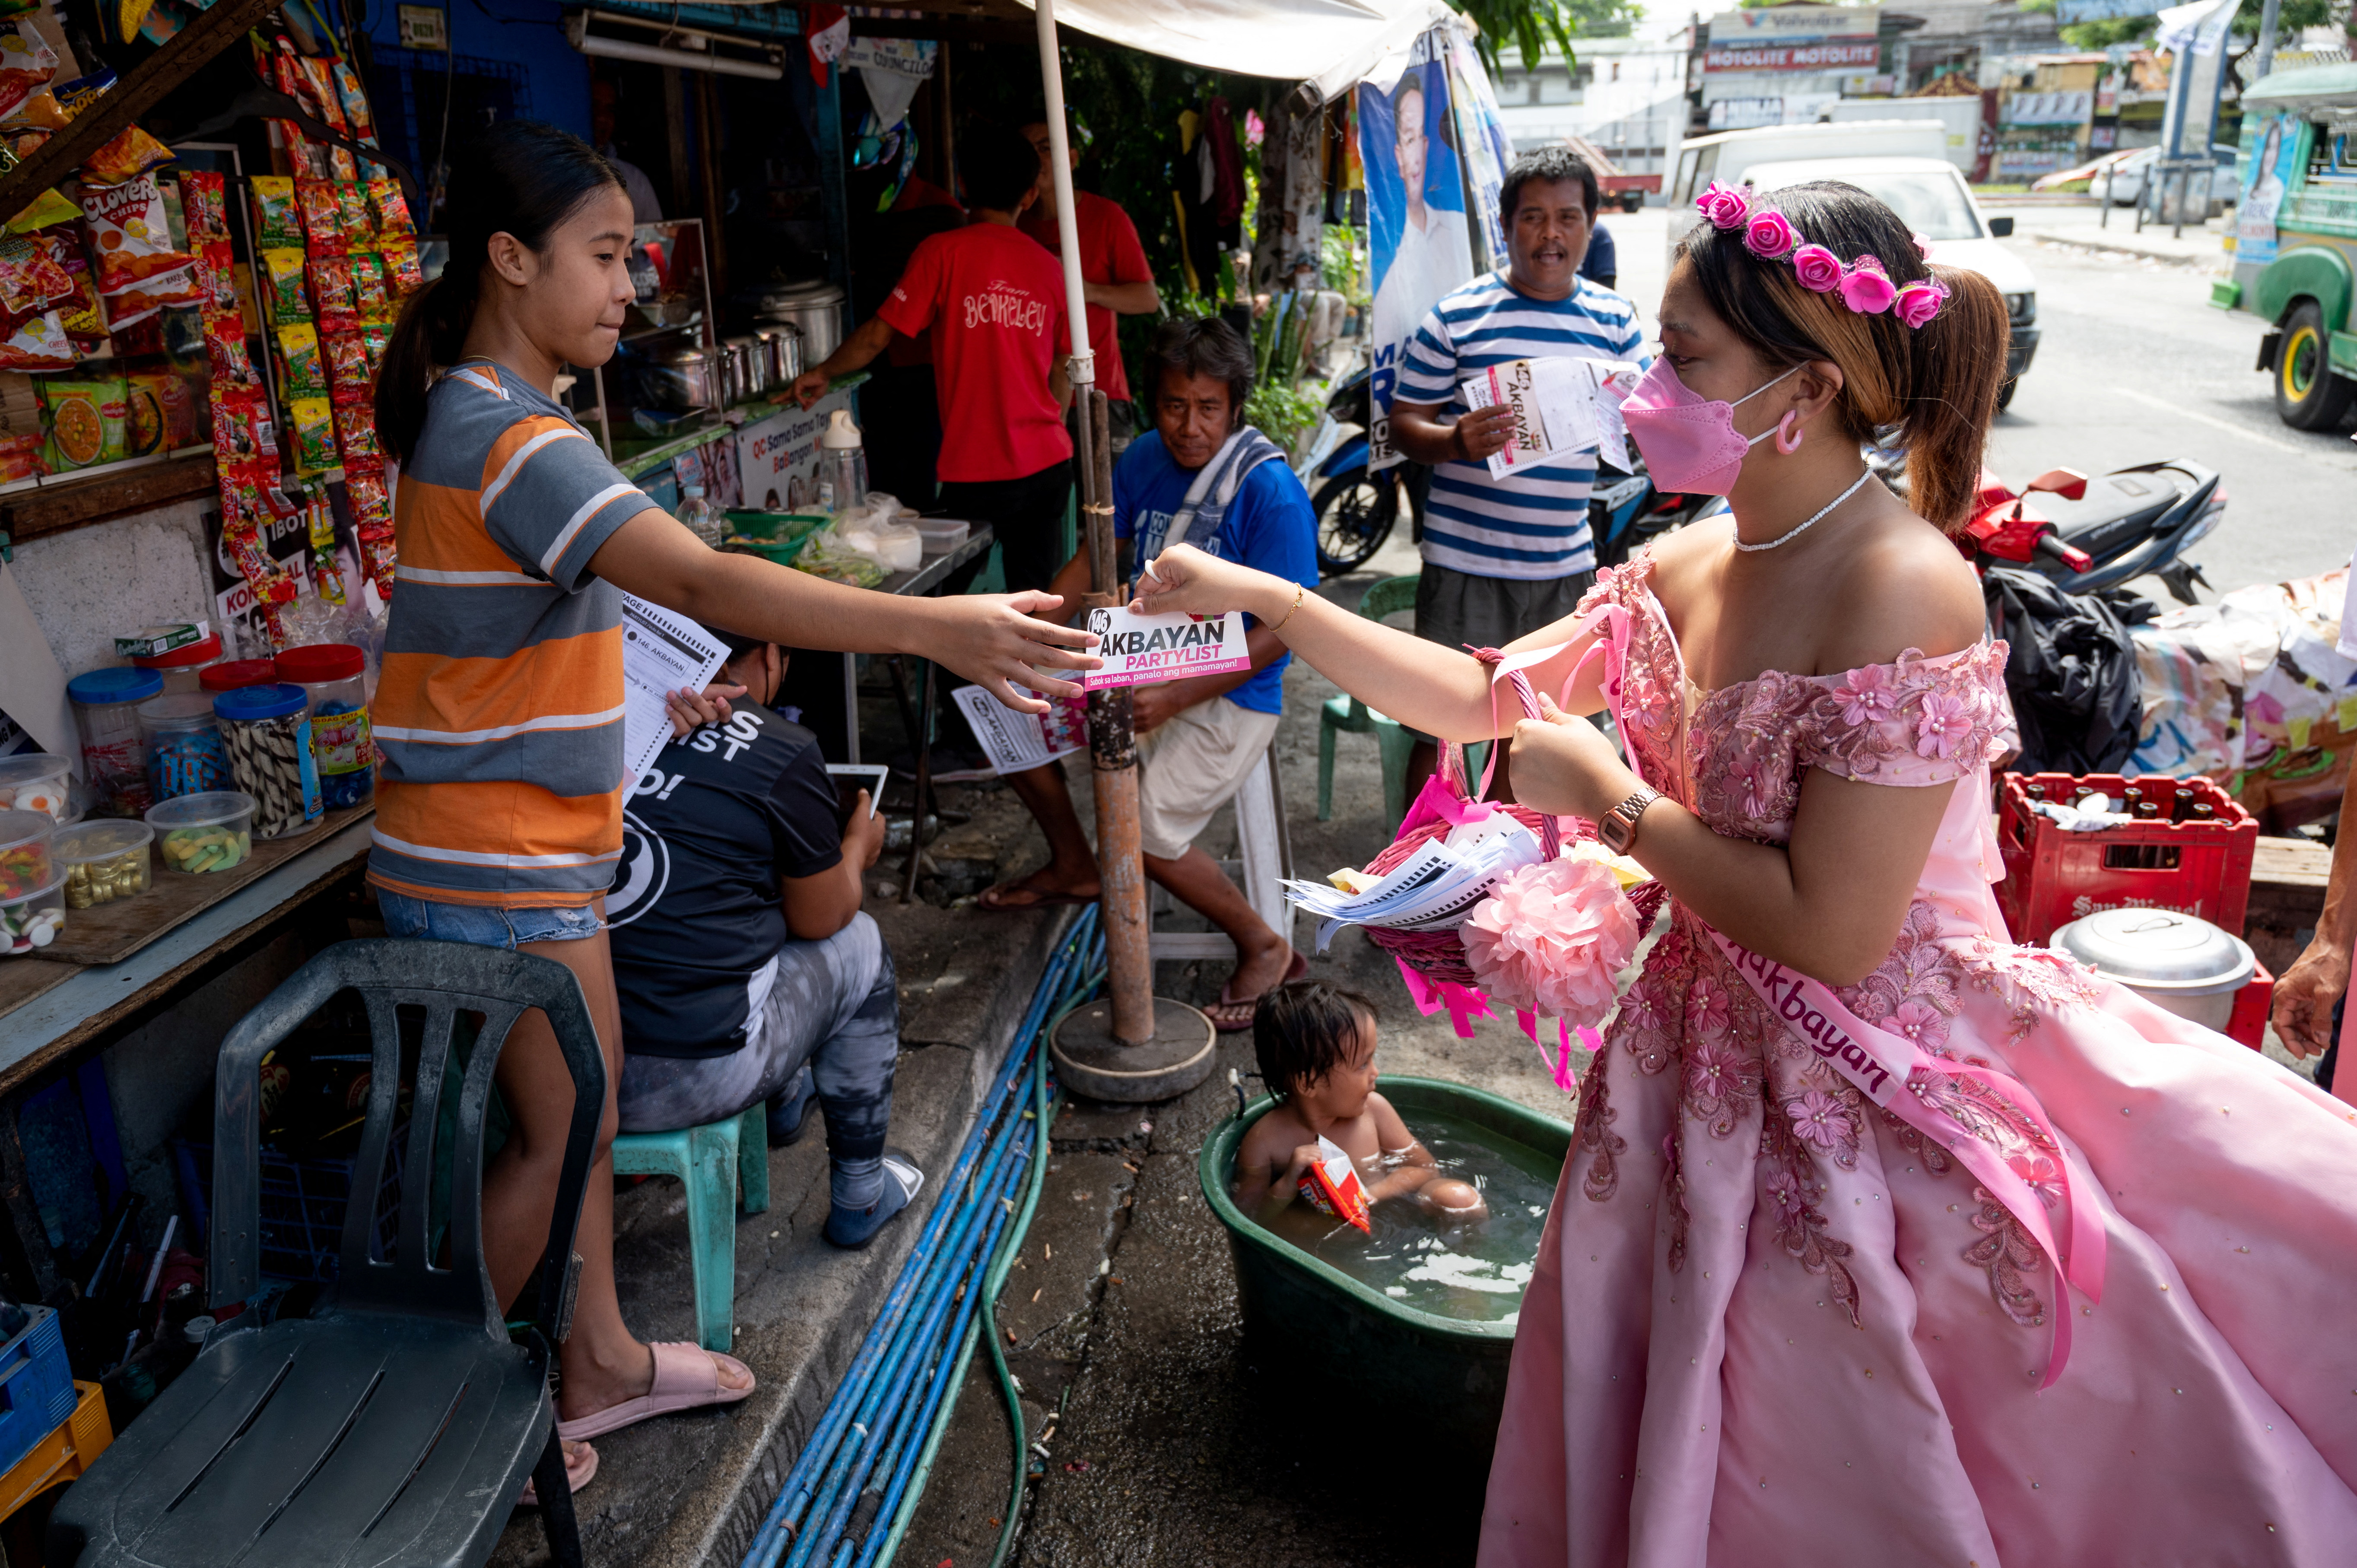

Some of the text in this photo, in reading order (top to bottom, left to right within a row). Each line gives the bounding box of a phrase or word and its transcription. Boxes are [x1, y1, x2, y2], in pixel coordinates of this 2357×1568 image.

[1707, 45, 1874, 67] MOTOLITE MOTOLITE
[83, 179, 158, 222] CLOVER
[109, 202, 149, 221] CHIPS
[987, 280, 1030, 296] Team
[963, 293, 1047, 337] BERKELEY
[286, 341, 315, 359] Muncher
[1516, 363, 1531, 390] 146
[299, 414, 330, 433] Muncher
[1507, 381, 1531, 451] AKBAYAN
[753, 411, 831, 460] QC Sama Sama Tay
[774, 435, 822, 473] BaBangon M
[630, 612, 648, 627] PARTYLIST
[1090, 611, 1109, 633] 146
[1099, 621, 1225, 657] AKBAYAN
[638, 638, 685, 671] 146. AKBAYAN
[1126, 644, 1223, 670] PARTYLIST
[1090, 675, 1104, 686] Subok
[1112, 674, 1132, 684] laban,
[1134, 670, 1162, 682] panalo
[1163, 668, 1180, 677] ang
[1182, 658, 1238, 674] mamamayan!
[316, 725, 358, 748] GOLF
[2071, 895, 2117, 917] San
